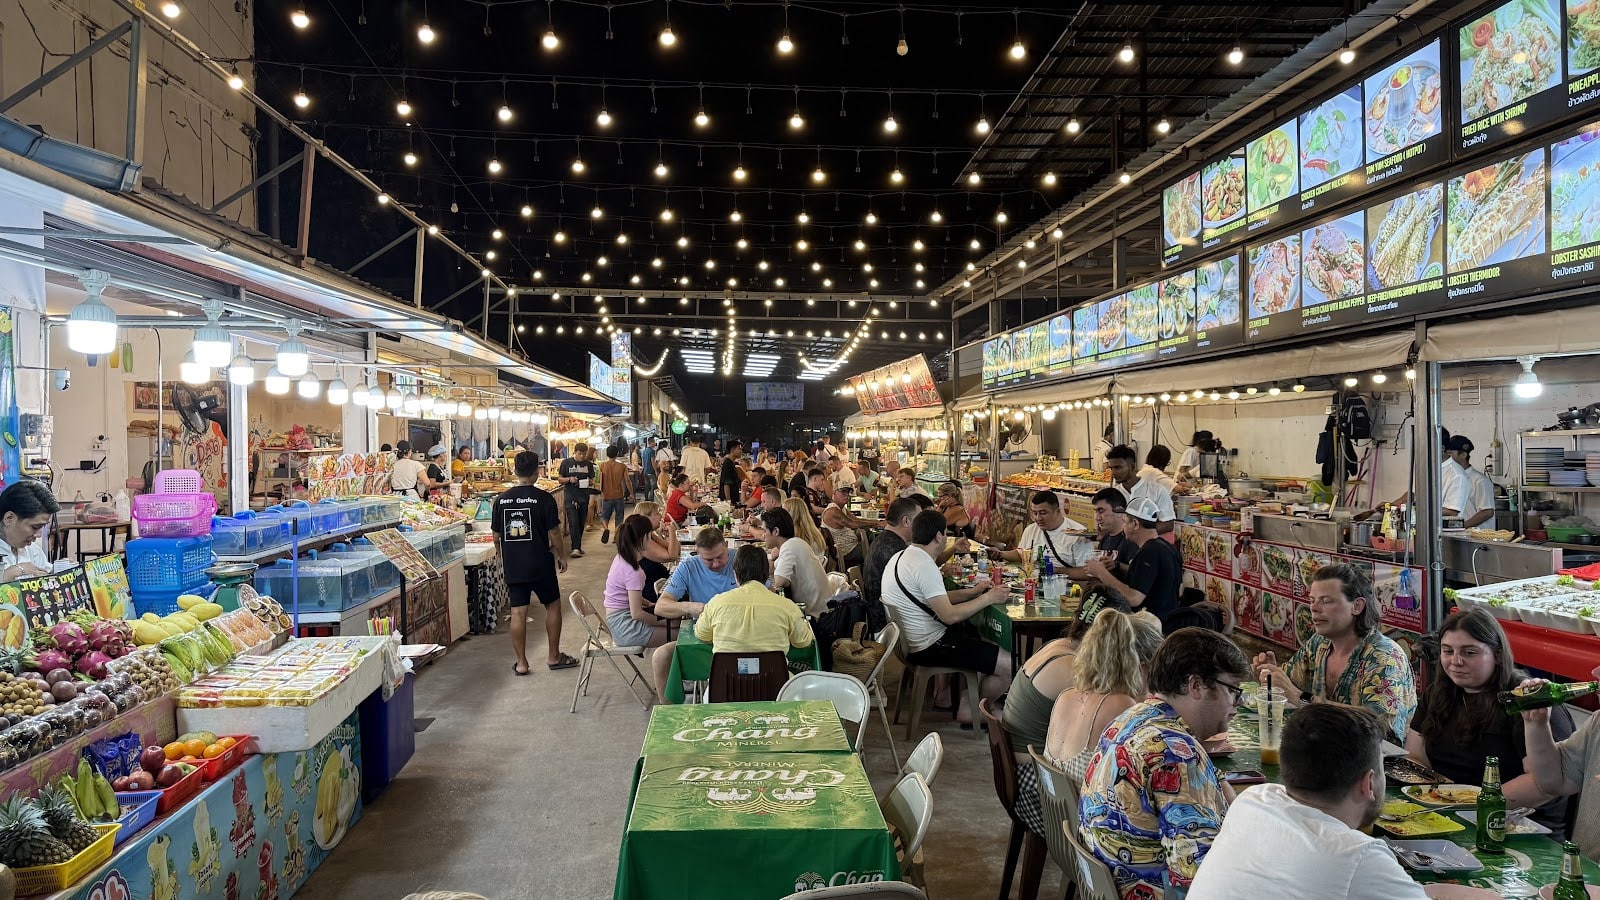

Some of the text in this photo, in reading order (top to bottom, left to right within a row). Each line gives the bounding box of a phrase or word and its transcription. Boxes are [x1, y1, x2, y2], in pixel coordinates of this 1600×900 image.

[1462, 102, 1528, 137] FRIED RICE WITH SHRIMP
[1551, 252, 1579, 266] LOBSTER
[1447, 267, 1501, 287] LOBSTER THERMIDOR
[672, 726, 819, 742] Chang
[677, 767, 846, 786] Chang
